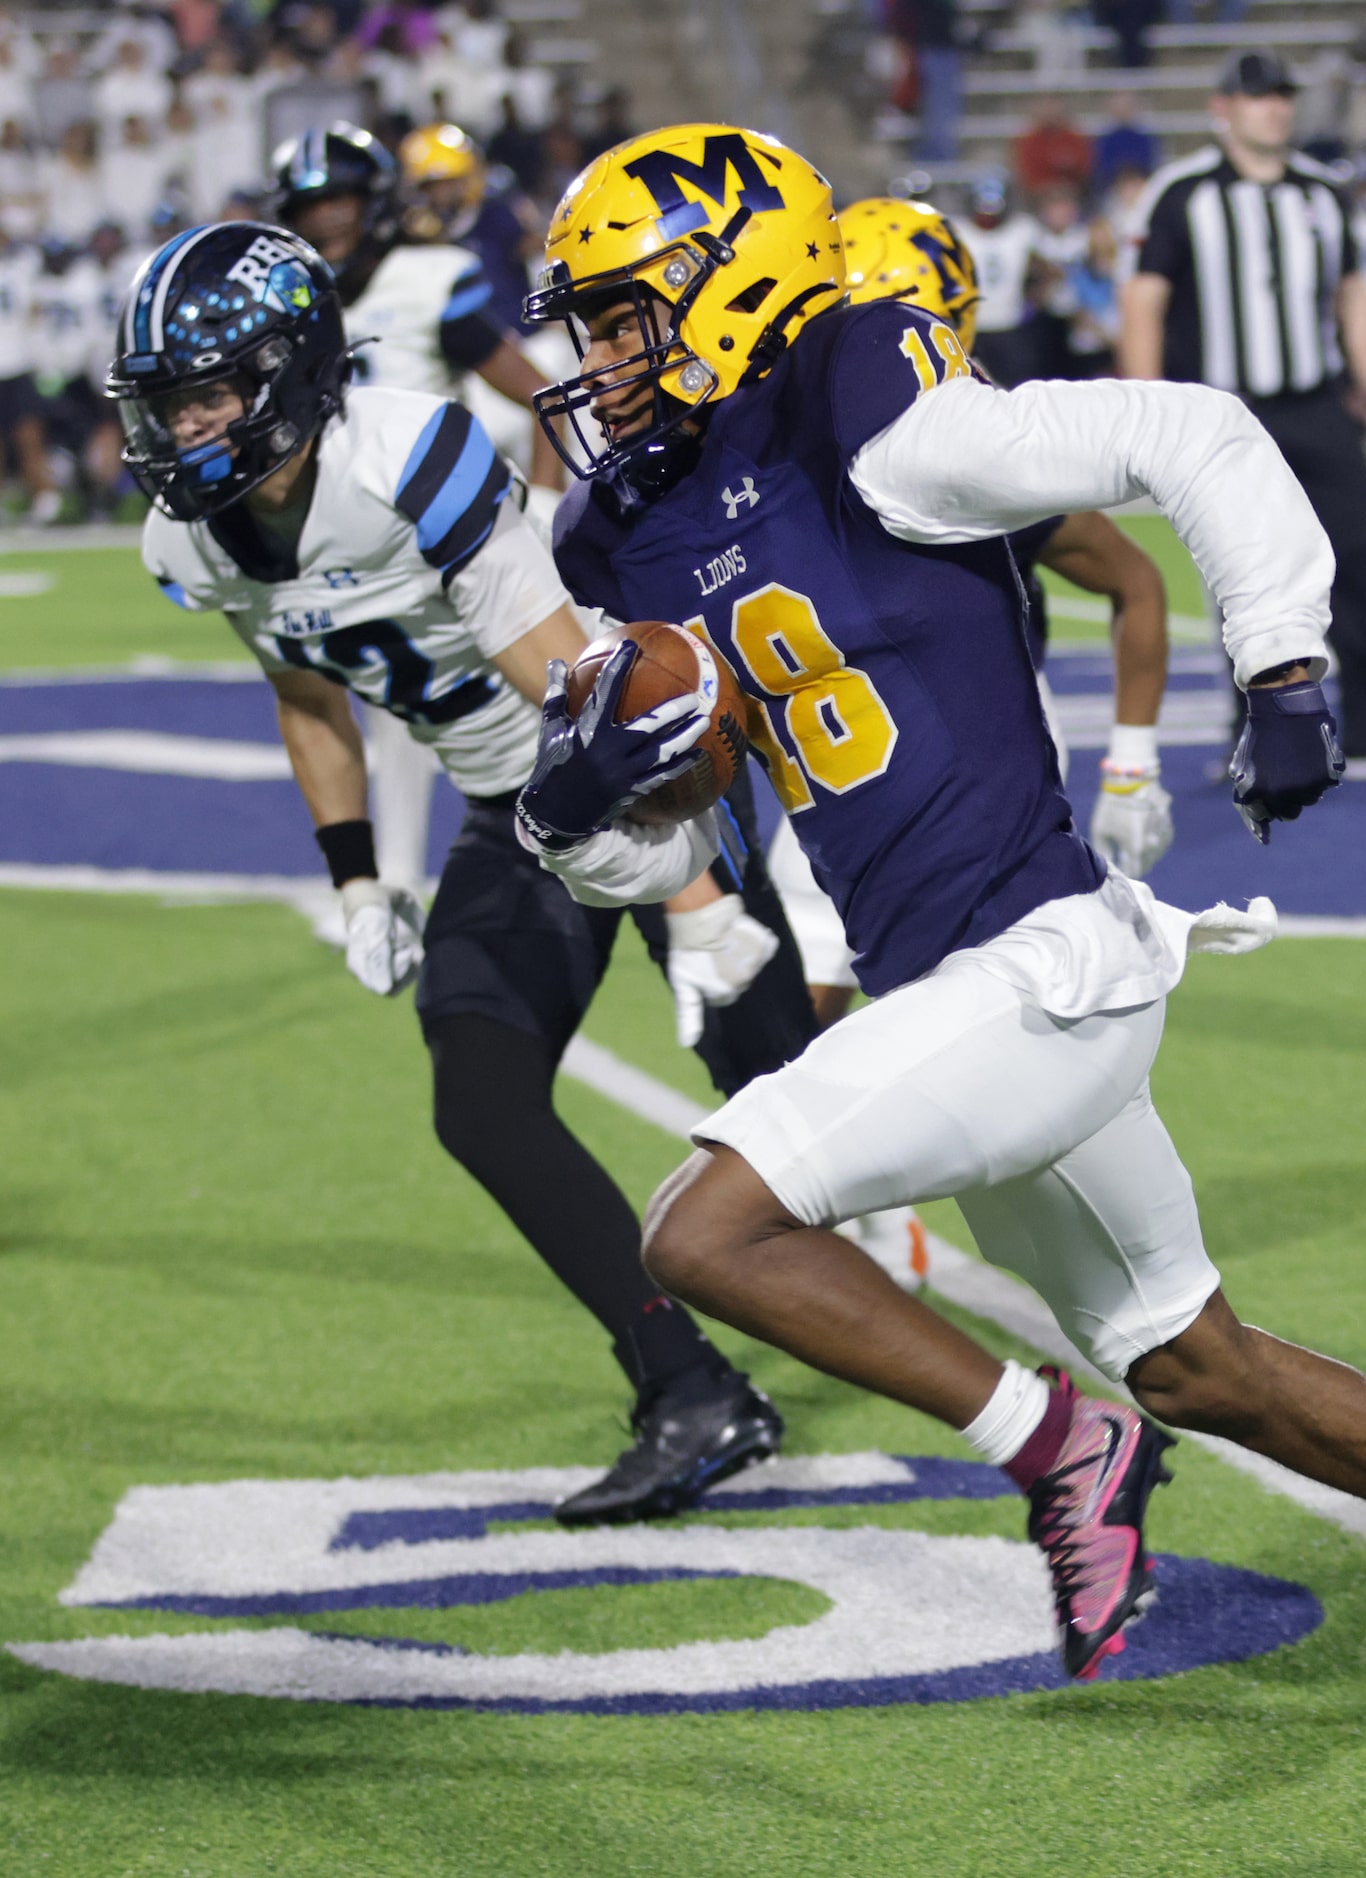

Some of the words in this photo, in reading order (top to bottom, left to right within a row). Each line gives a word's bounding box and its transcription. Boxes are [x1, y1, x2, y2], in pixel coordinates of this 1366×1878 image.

[621, 133, 786, 242] M
[899, 322, 972, 399] 18
[693, 544, 747, 597] LIONS
[682, 581, 900, 815] 18
